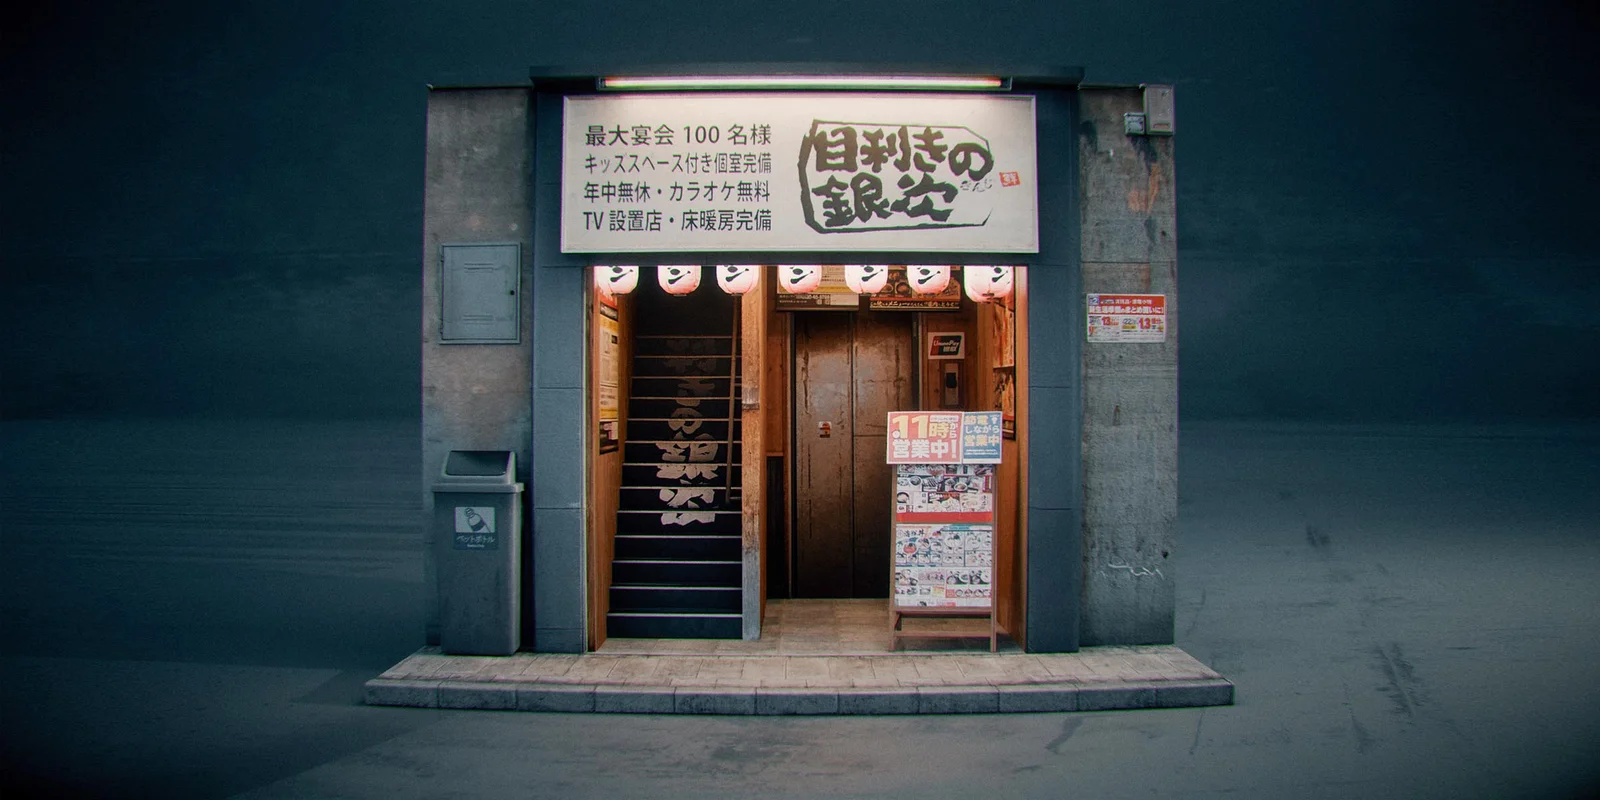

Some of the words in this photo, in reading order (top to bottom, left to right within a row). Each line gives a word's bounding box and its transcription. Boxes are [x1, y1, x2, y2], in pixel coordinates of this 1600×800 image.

[585, 124, 674, 146] 最大宴会
[683, 125, 720, 143] 100
[727, 123, 772, 145] 名様
[813, 126, 994, 181] 目利きの
[583, 180, 770, 204] 年中無休・カラオケ無料
[811, 171, 958, 228] 銀次
[583, 211, 604, 231] TV
[609, 209, 772, 232] 設置店・床暖房完備
[965, 425, 1000, 434] しながら
